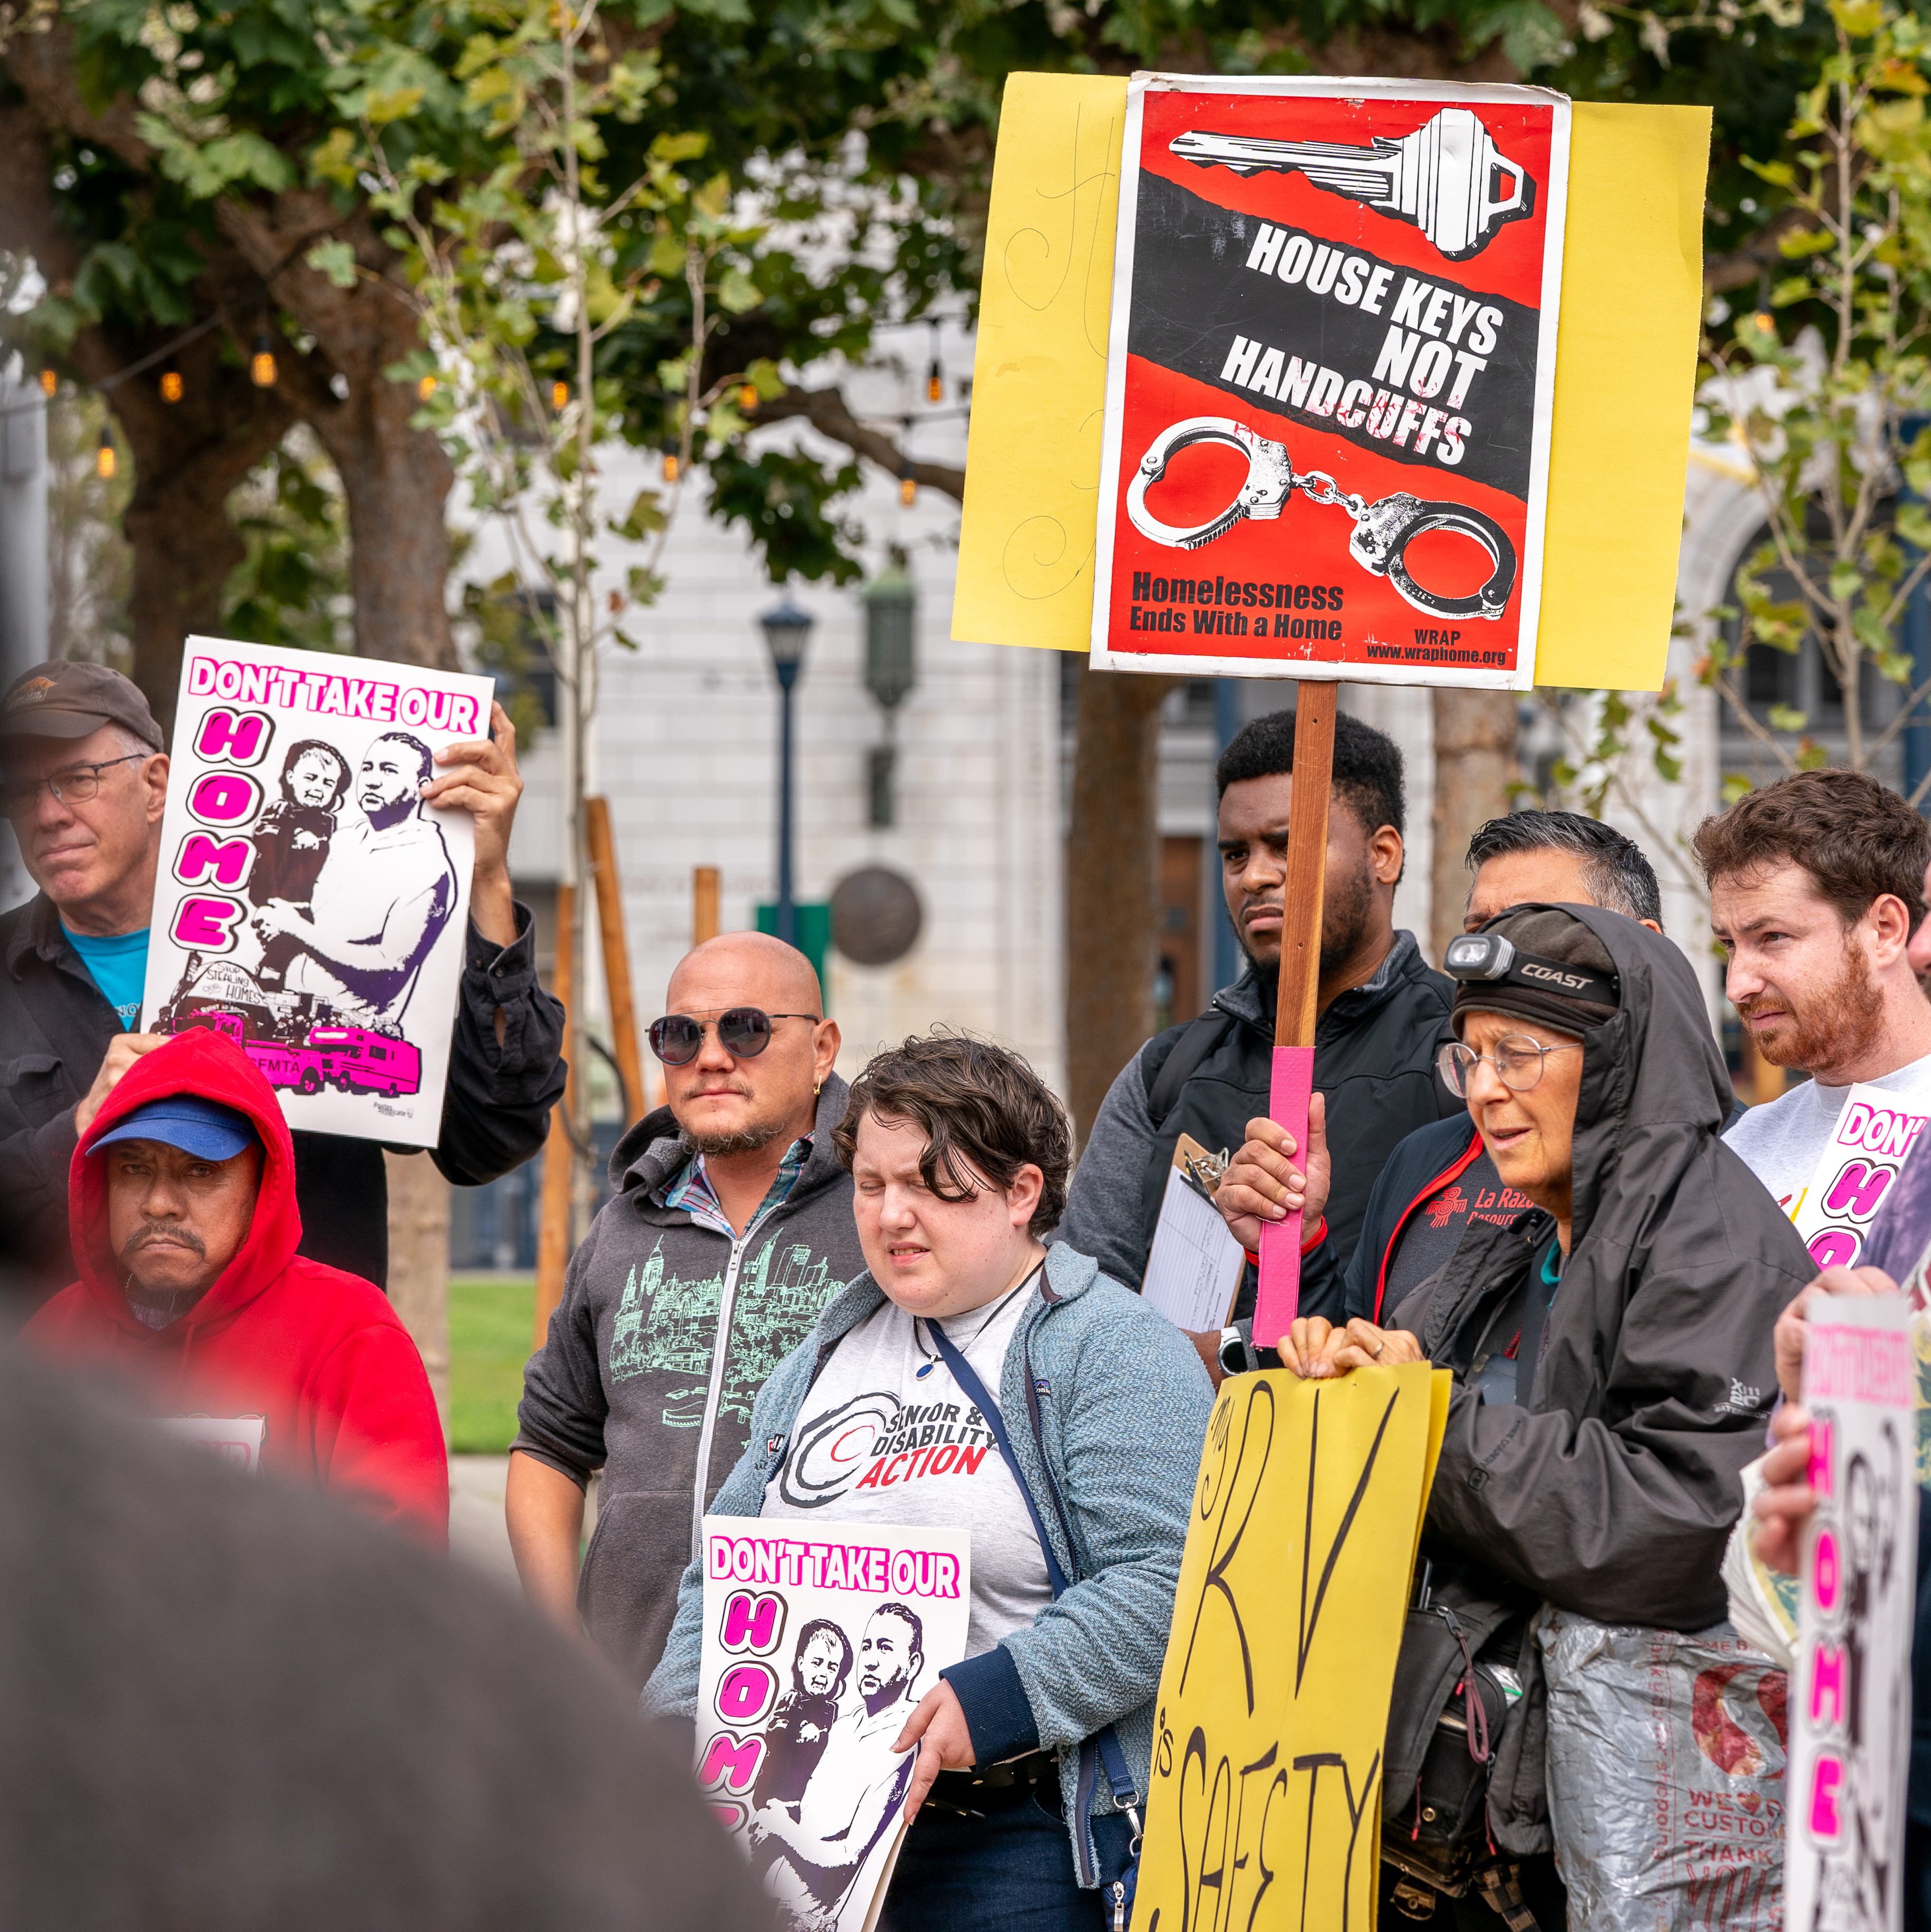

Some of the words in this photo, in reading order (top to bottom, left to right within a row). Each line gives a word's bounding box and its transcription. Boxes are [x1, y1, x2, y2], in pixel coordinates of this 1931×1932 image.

[1245, 223, 1395, 315] HOUSE
[1390, 276, 1503, 354] KEYS
[1371, 325, 1488, 410] NOT
[1219, 334, 1472, 465] HANDCUFFS
[1132, 572, 1343, 611] Homelessness
[1130, 606, 1186, 632] Ends
[1193, 610, 1247, 635] With
[1255, 615, 1267, 636] a
[1274, 614, 1342, 640] Home
[1415, 629, 1460, 645] WRAP
[1367, 645, 1506, 665] www.wraphome.org
[188, 657, 305, 708] DON'T
[305, 672, 399, 721] TAKE
[401, 688, 479, 734] OUR
[170, 707, 276, 953] HOME
[1520, 963, 1594, 989] COAST
[226, 984, 260, 1004] HOMES
[253, 1056, 300, 1073] FMTA
[1837, 1103, 1930, 1157] DON'
[1474, 1188, 1496, 1208] La
[886, 1402, 960, 1433] SENIOR
[966, 1406, 984, 1426] &
[870, 1424, 998, 1457] DISABILITY
[856, 1446, 988, 1489] ACTION
[711, 1536, 809, 1585] DON'T
[809, 1543, 889, 1592] TAKE
[892, 1550, 959, 1599] OUR
[1688, 1788, 1734, 1812] WE
[1148, 1725, 1380, 1932] SAFETY
[1683, 1839, 1773, 1866] THANK
